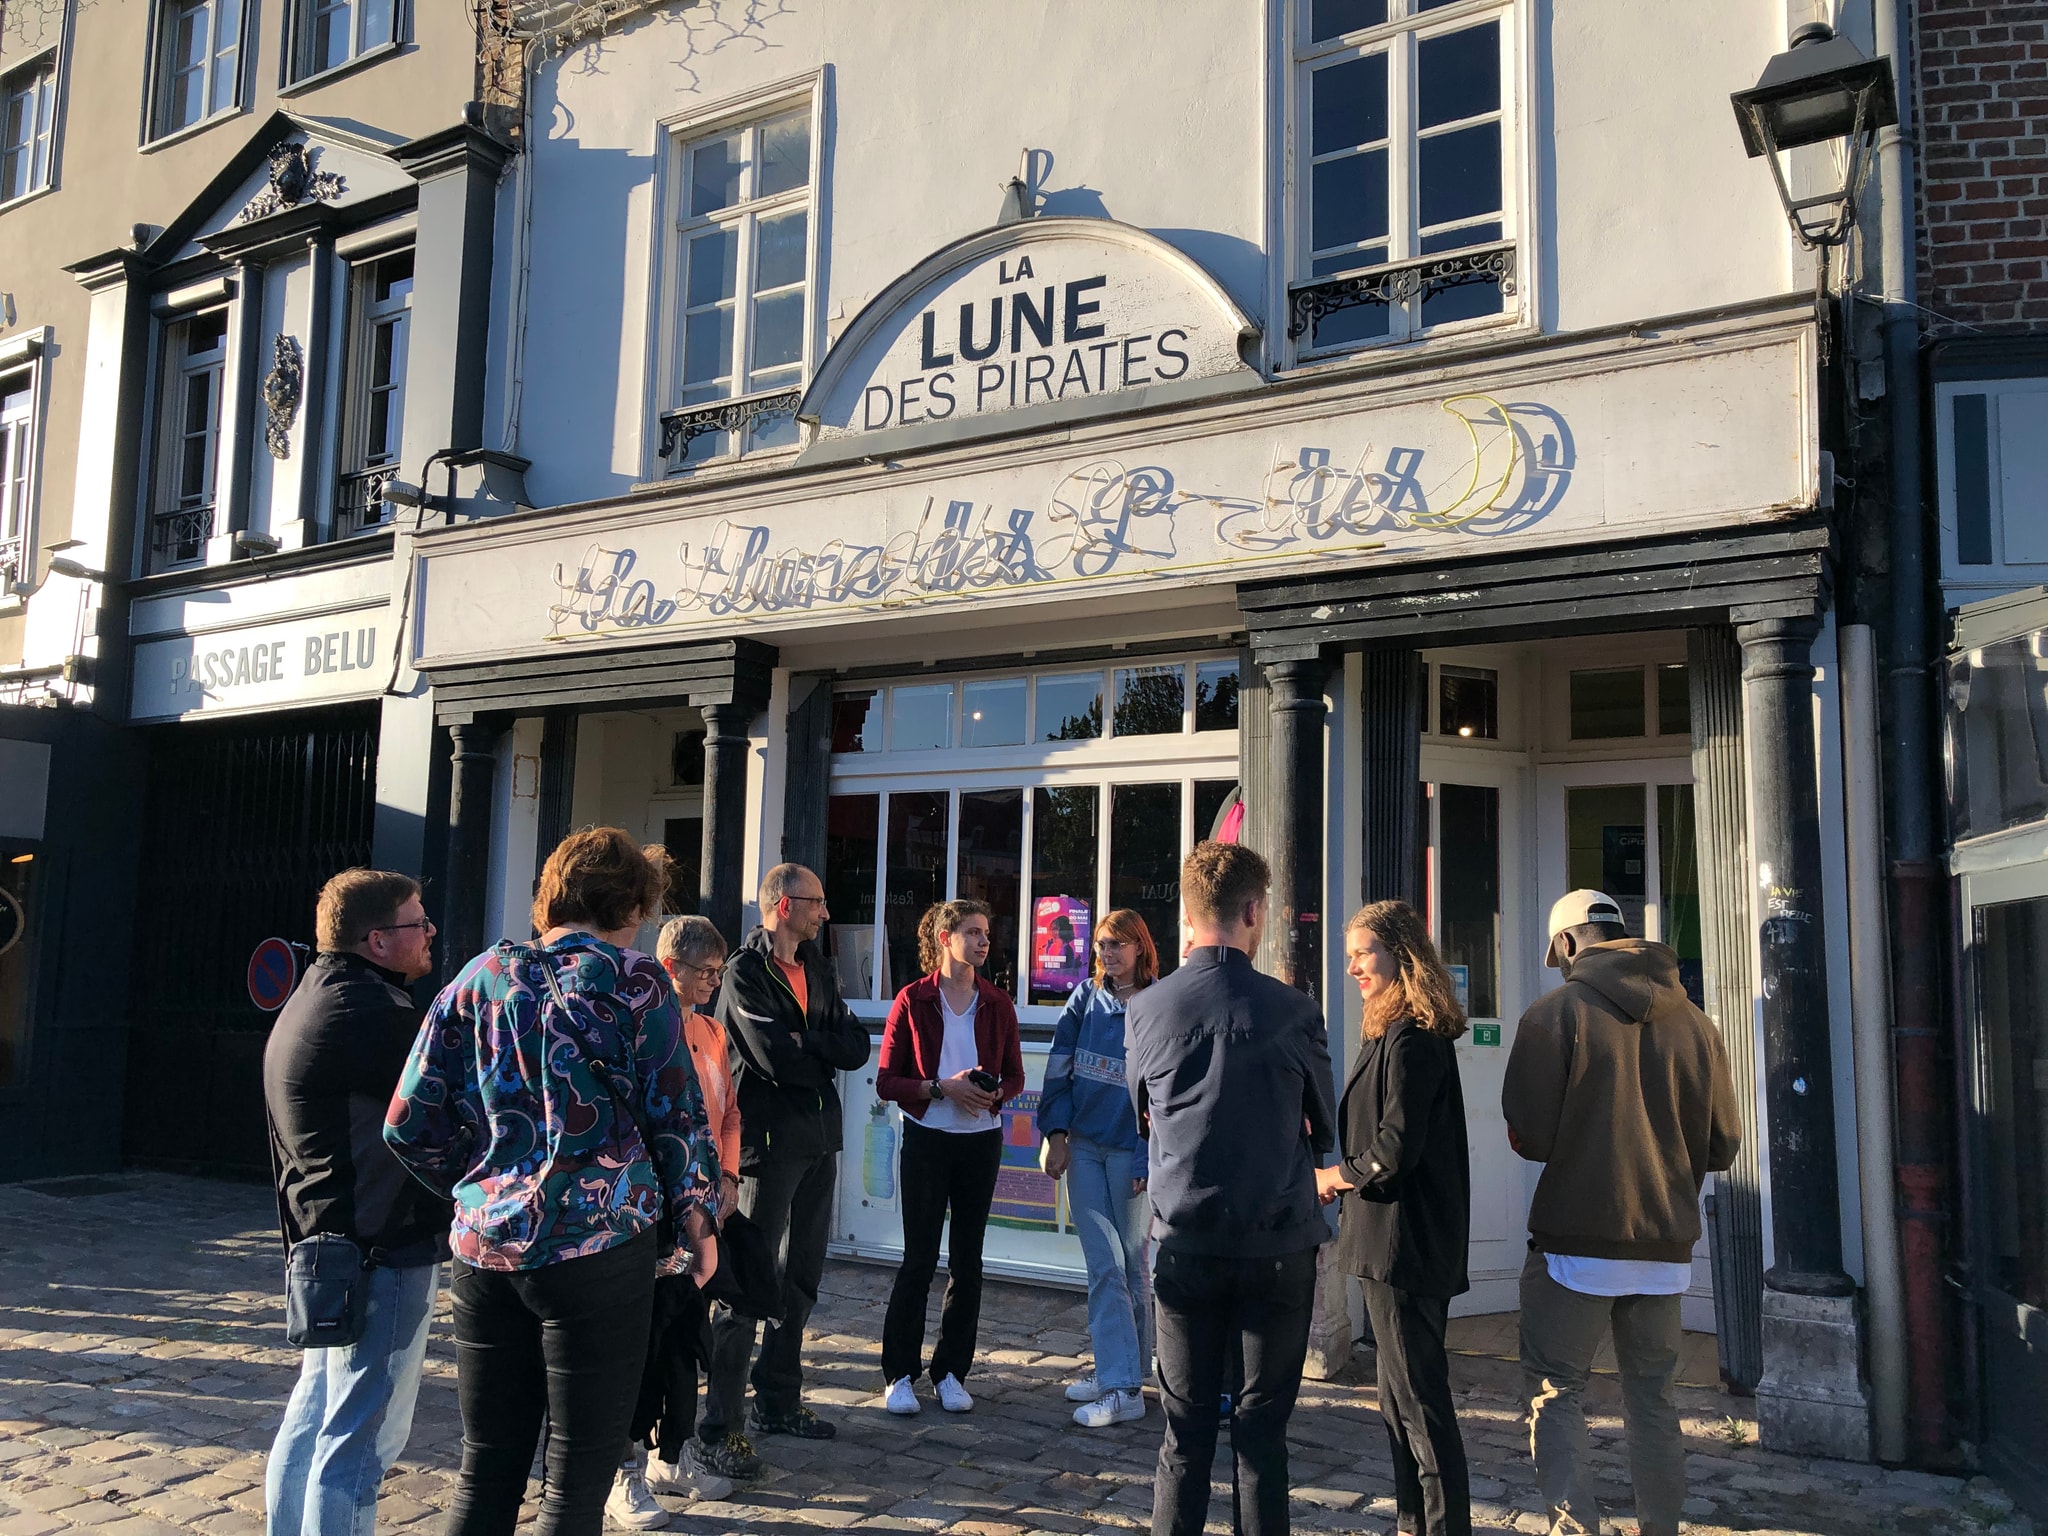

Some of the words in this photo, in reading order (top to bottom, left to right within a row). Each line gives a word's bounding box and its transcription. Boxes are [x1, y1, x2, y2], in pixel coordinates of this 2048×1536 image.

[999, 255, 1035, 285] LA
[921, 274, 1107, 371] LUNE
[864, 371, 956, 432] DES
[977, 328, 1190, 412] PIRATES
[1034, 440, 1410, 570] Ptes
[170, 641, 286, 695] PASSAGE
[304, 627, 376, 676] BELU
[1767, 897, 1790, 910] EST
